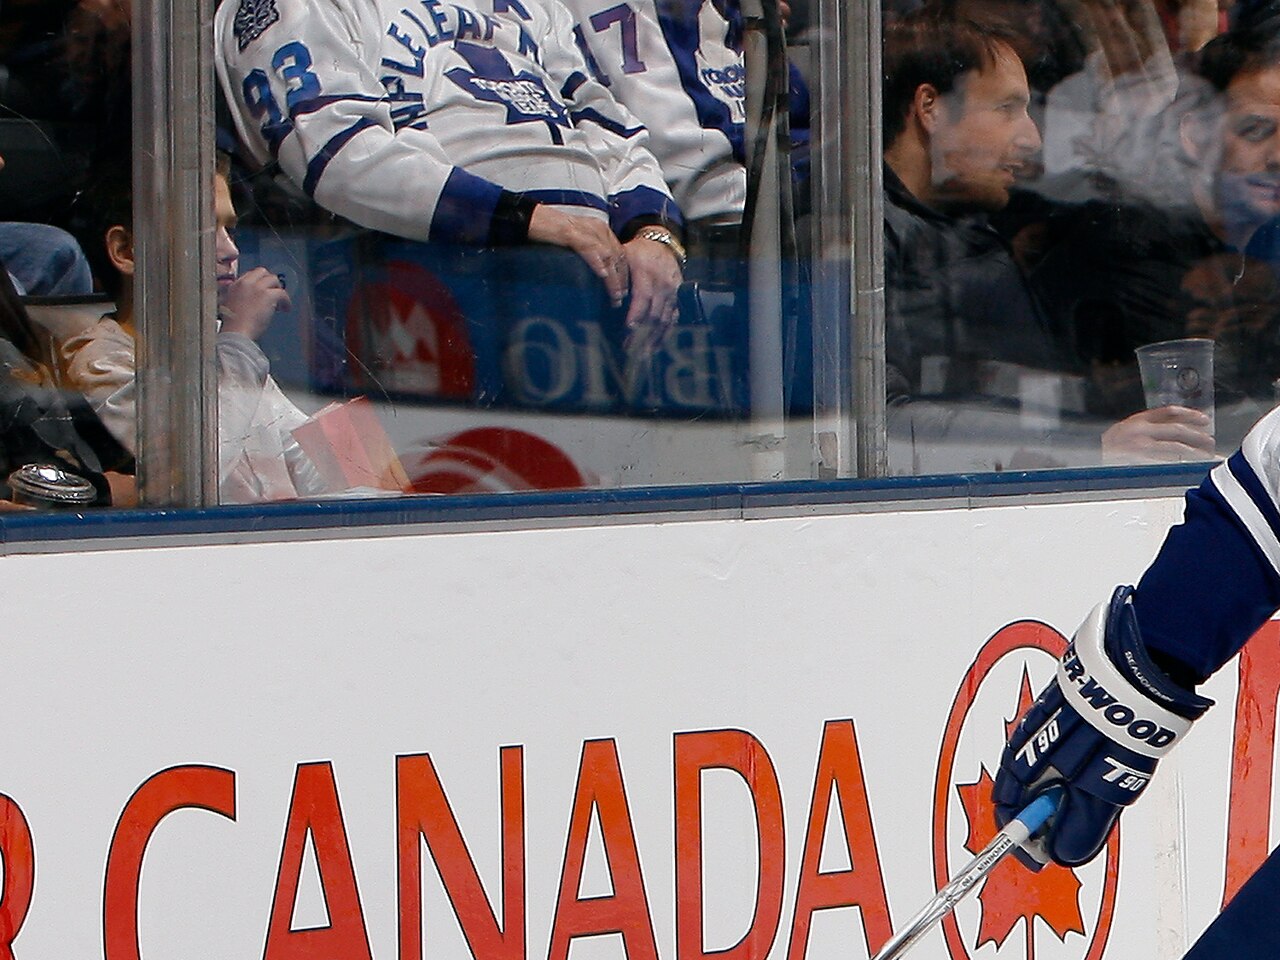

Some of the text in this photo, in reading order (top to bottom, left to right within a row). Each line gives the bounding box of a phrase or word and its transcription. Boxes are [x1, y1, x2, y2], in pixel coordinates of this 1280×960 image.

[242, 40, 321, 124] 93
[1062, 650, 1177, 749] ER-WOOD
[1014, 707, 1062, 768] T90
[1103, 756, 1152, 792] T90
